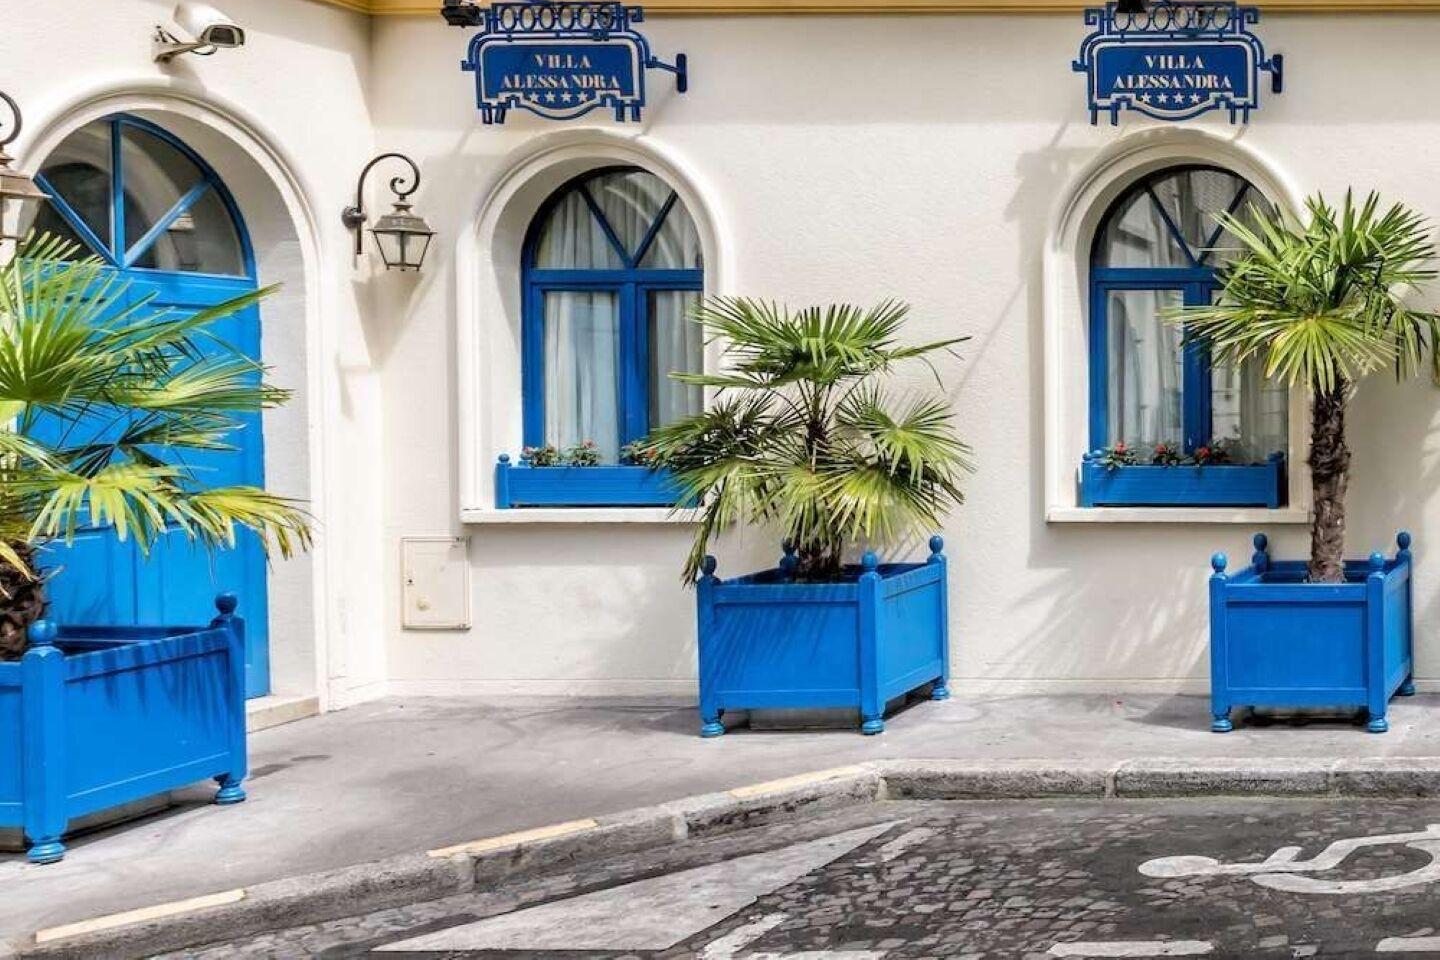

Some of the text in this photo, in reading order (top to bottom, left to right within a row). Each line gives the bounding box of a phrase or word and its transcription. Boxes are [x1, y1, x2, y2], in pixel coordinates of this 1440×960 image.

[534, 54, 591, 69] VILLA
[1145, 54, 1204, 69] VILLA
[503, 74, 620, 89] ALESSANDRA
[1113, 74, 1232, 89] ALESSANDRA
